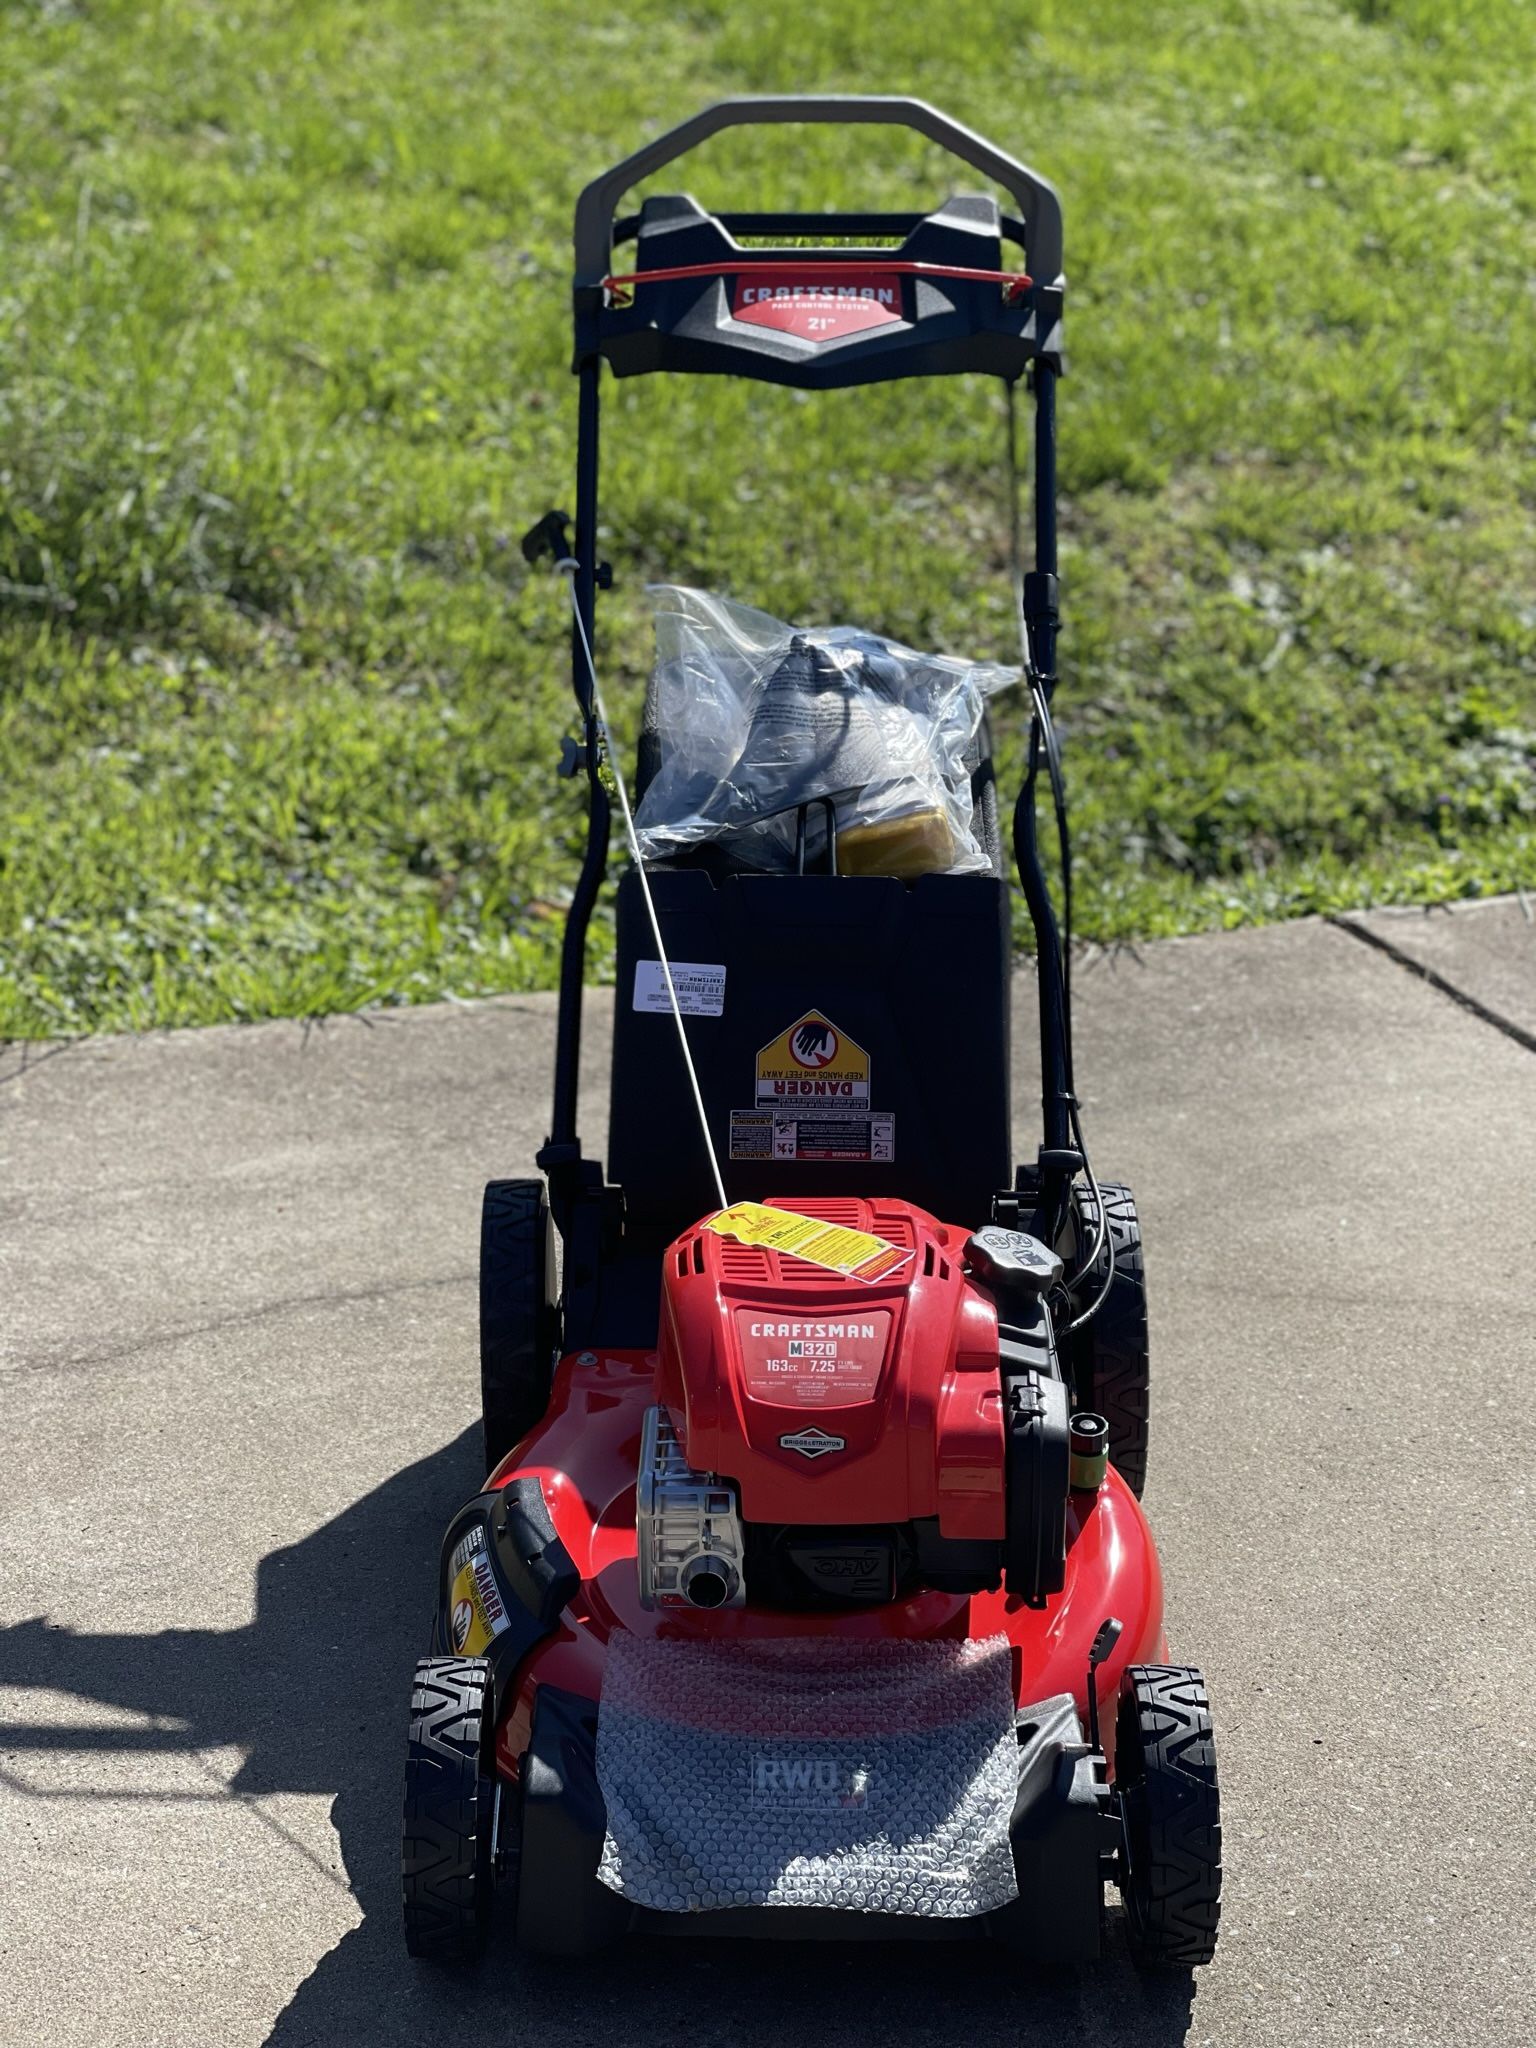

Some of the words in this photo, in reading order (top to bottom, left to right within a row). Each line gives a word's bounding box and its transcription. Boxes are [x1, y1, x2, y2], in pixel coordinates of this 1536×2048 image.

[743, 286, 893, 304] CRAFTSMAN
[762, 1070, 783, 1079] AWAY
[785, 1070, 803, 1079] FEET
[804, 1070, 817, 1079] and
[818, 1071, 844, 1080] HANDS
[844, 1071, 864, 1080] KEEP
[773, 1080, 853, 1096] DANGER
[751, 1323, 875, 1339] CRAFTSMAN
[789, 1342, 836, 1356] M320
[810, 1359, 836, 1373] 7.25
[475, 1561, 503, 1624] DANGER
